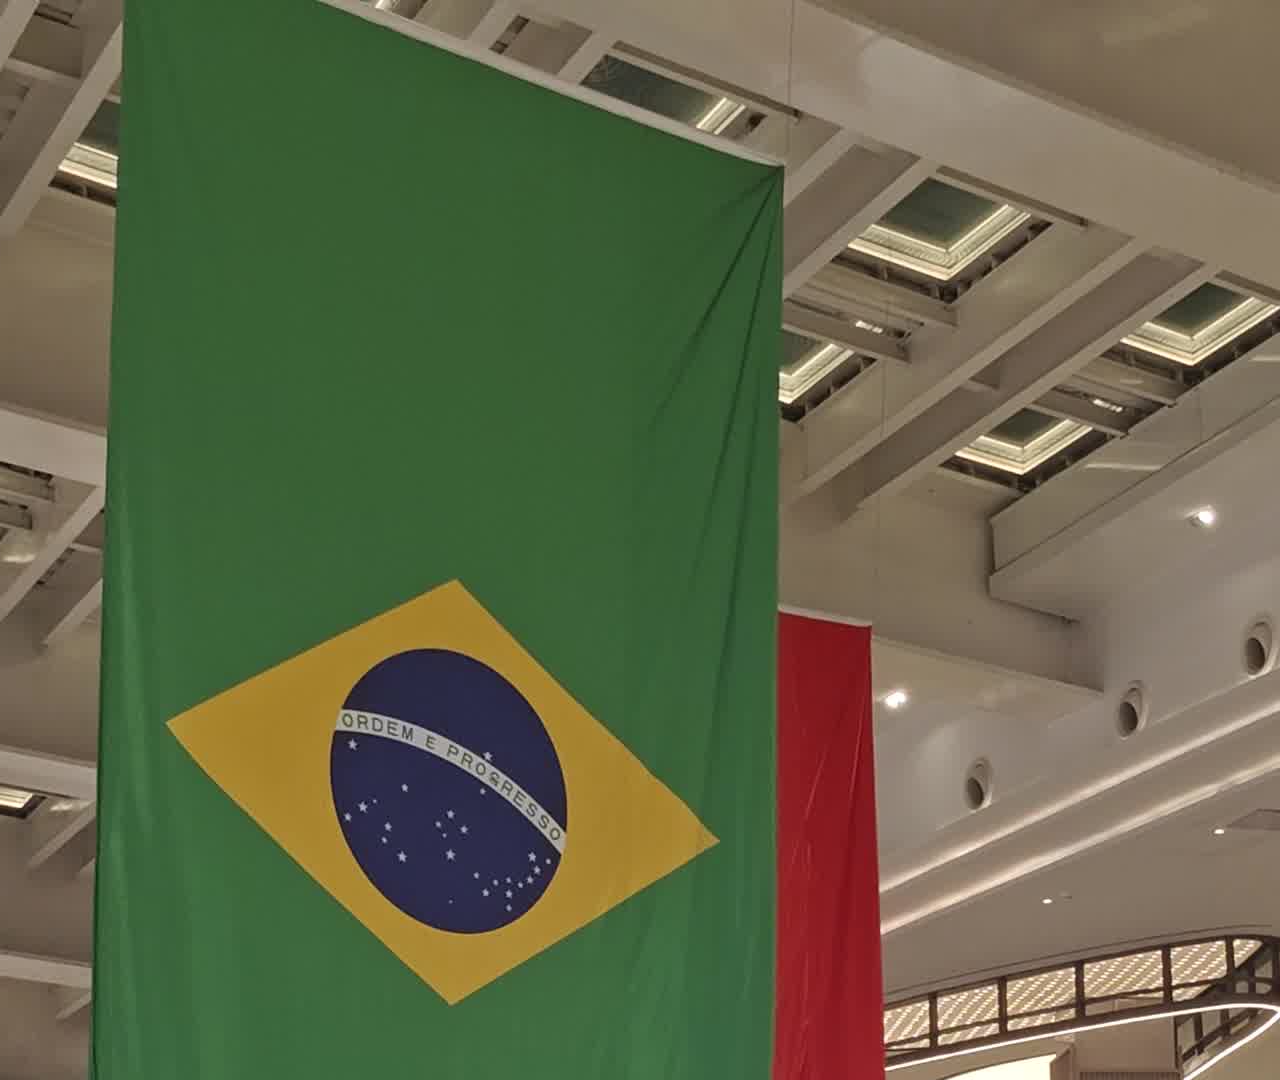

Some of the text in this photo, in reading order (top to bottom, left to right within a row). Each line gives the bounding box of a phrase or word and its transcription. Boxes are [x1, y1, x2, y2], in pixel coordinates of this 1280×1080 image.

[342, 713, 562, 841] ORDEM E PROGRESSO
